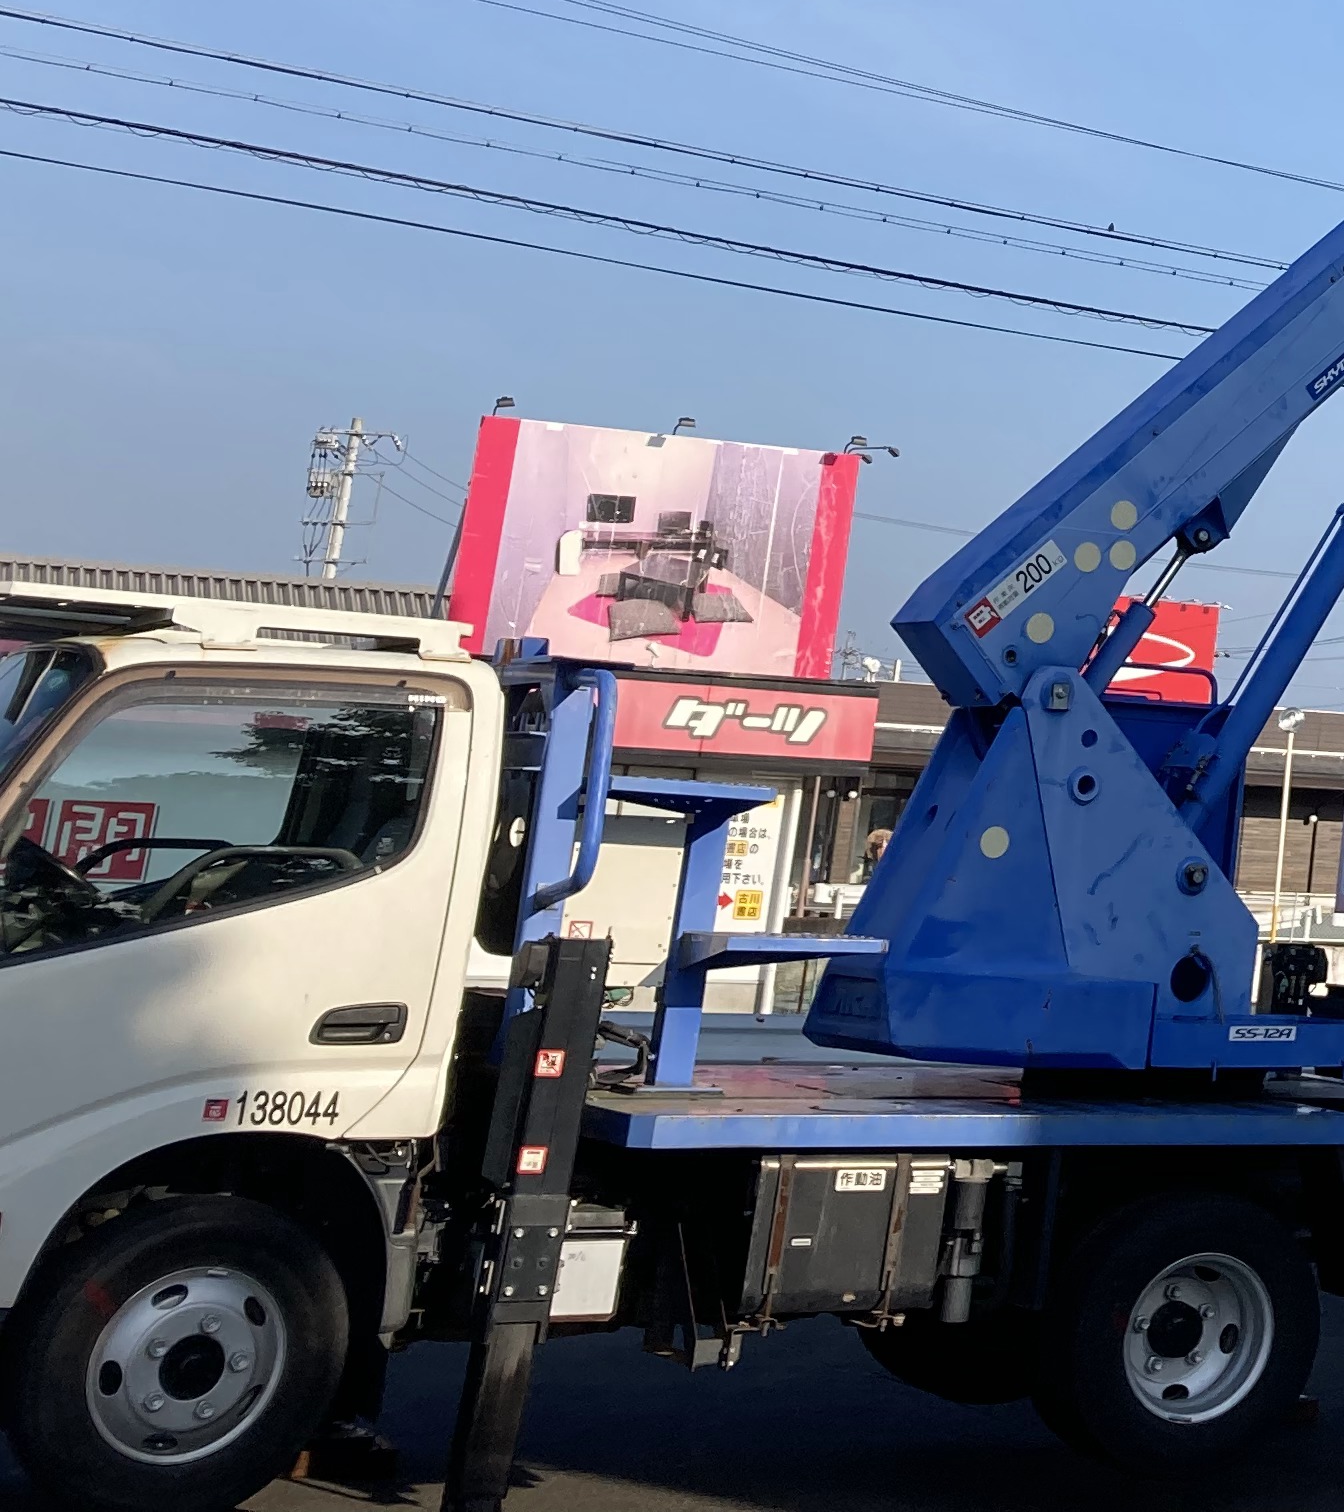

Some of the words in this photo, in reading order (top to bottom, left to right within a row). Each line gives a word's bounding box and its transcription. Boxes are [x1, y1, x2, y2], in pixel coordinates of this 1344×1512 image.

[1015, 553, 1052, 594] 200
[663, 695, 829, 745] ダーツ
[738, 893, 761, 904] 古川
[1232, 1028, 1294, 1040] SS-12A
[236, 1090, 339, 1126] 138044
[840, 1172, 883, 1187] 作動油
